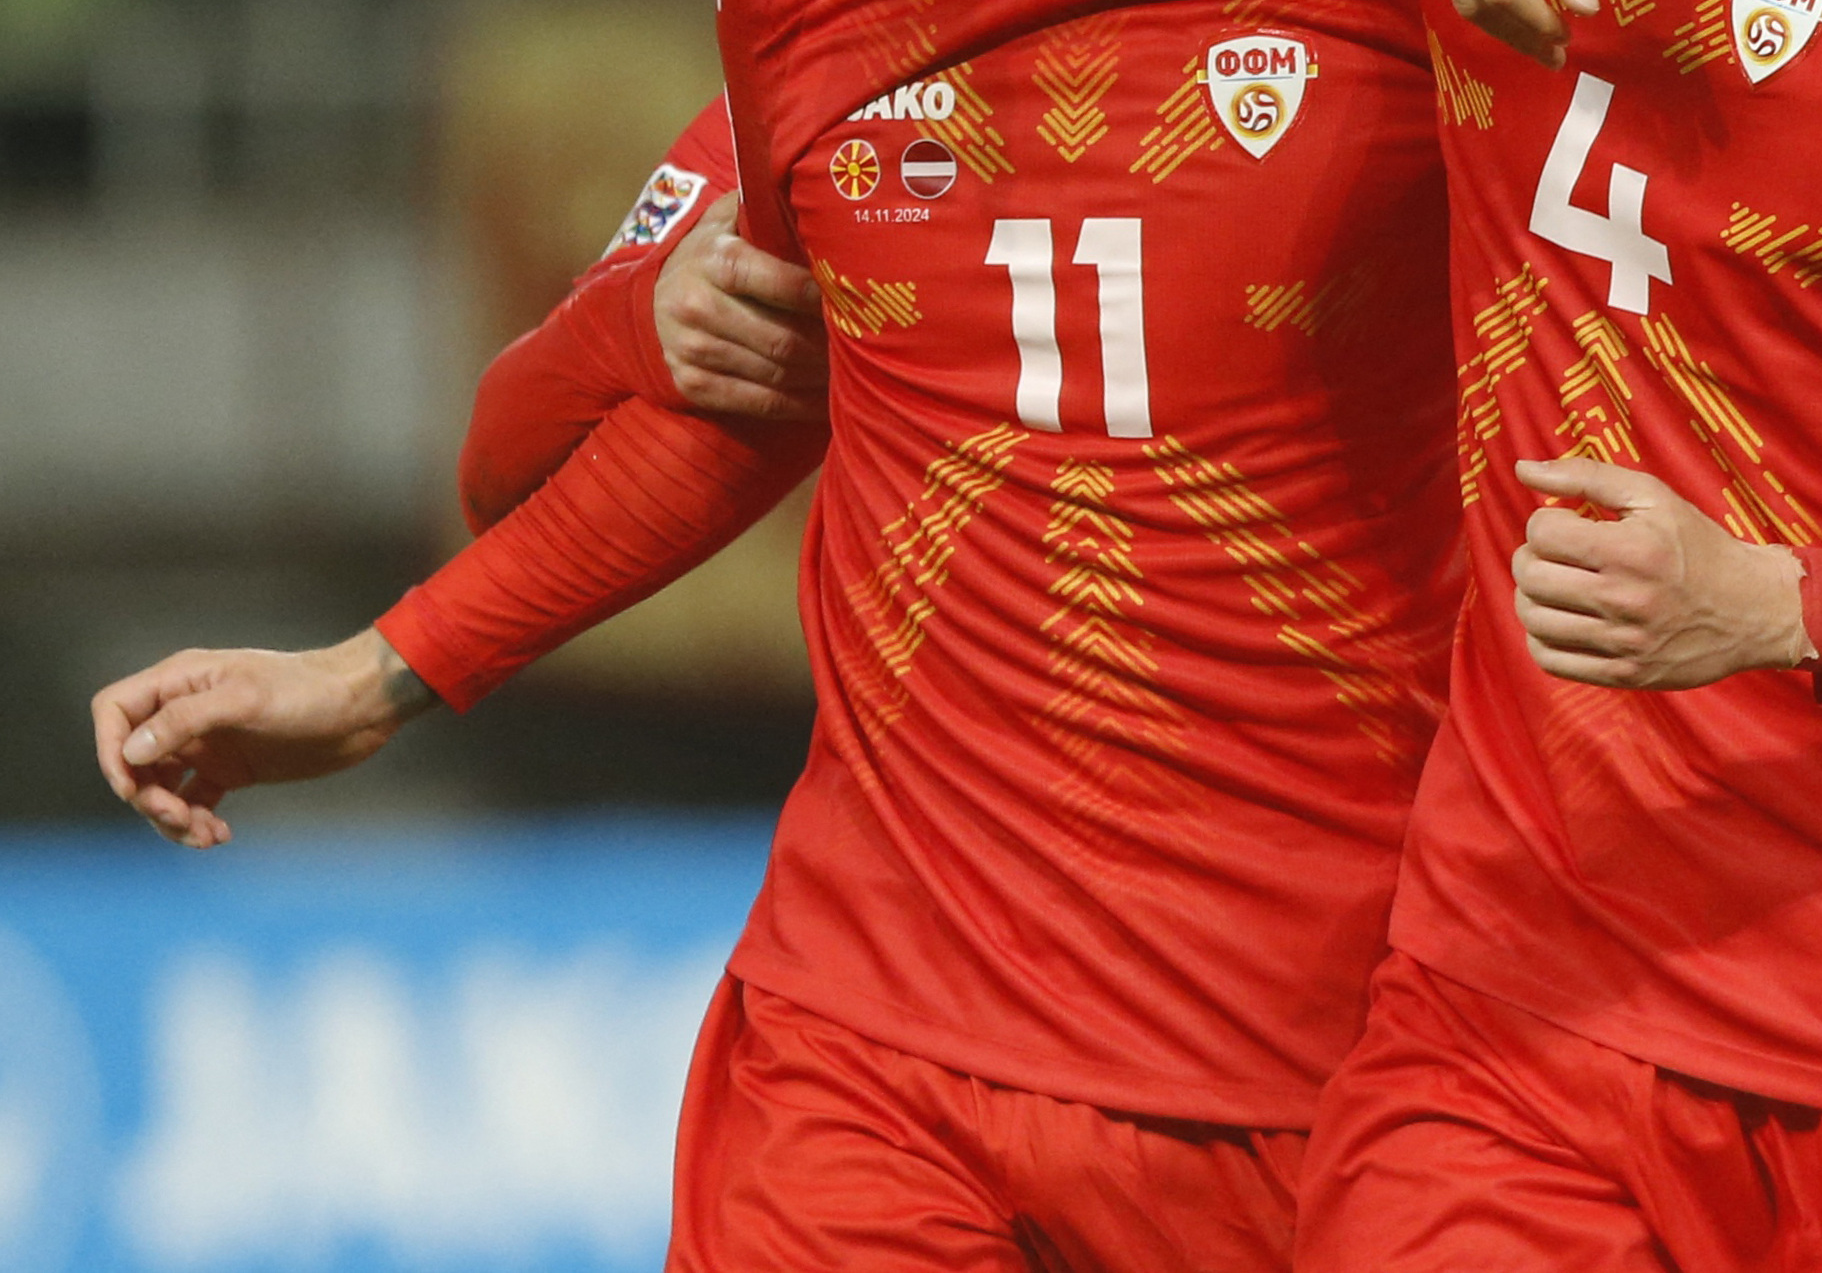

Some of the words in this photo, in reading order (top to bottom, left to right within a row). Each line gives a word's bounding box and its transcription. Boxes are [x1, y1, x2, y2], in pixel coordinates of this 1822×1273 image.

[1215, 46, 1297, 78] ФФМ
[847, 81, 956, 122] AKO
[1528, 70, 1674, 316] 4
[853, 207, 931, 224] 14.11.2024
[984, 217, 1154, 439] 11
